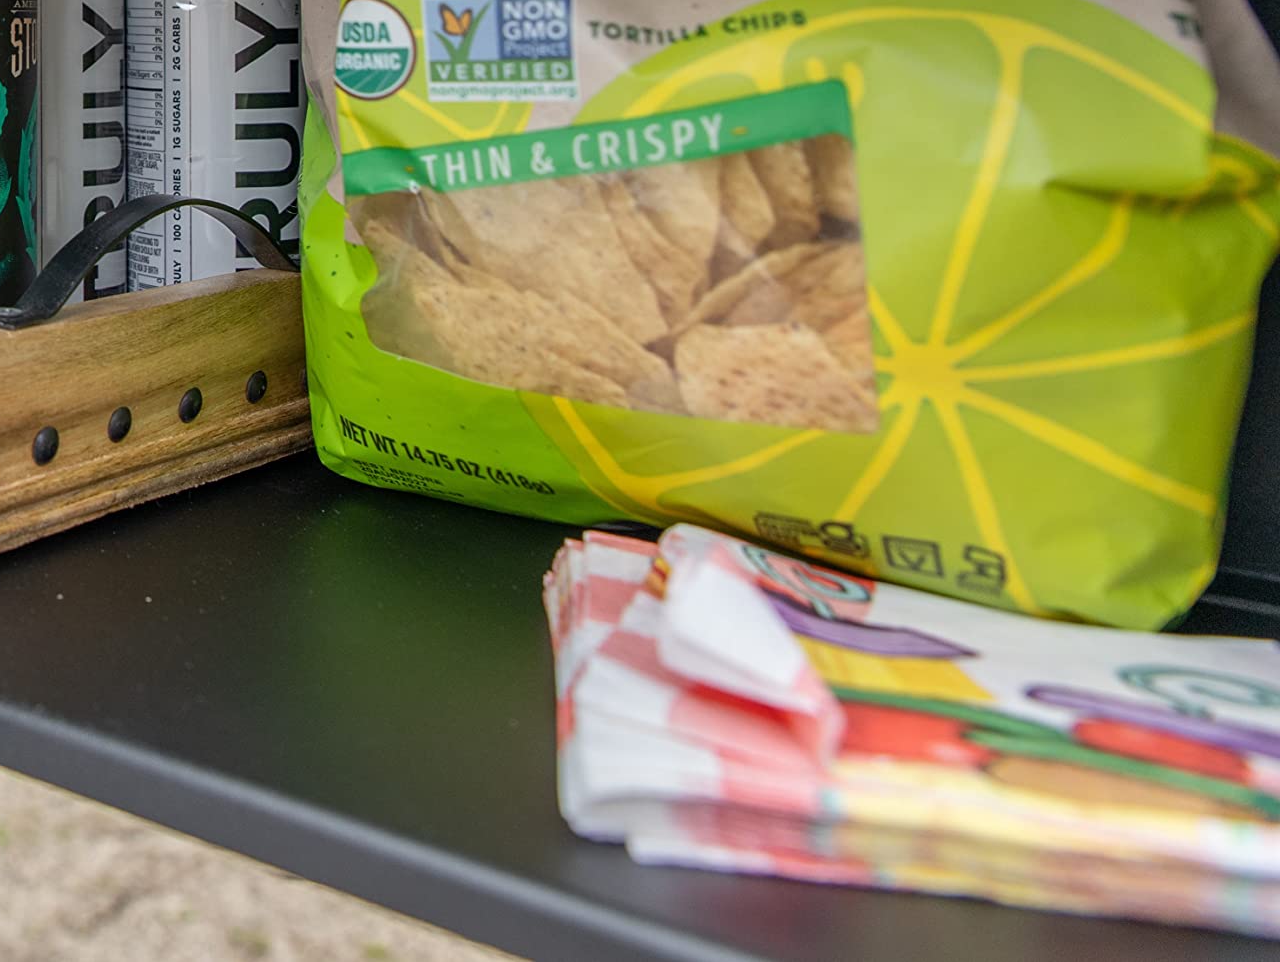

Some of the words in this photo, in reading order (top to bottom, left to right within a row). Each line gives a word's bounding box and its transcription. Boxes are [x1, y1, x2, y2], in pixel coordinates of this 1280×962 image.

[502, 0, 567, 19] NON
[173, 17, 181, 53] CARBS
[342, 21, 391, 43] USDA
[502, 21, 568, 39] GMO
[588, 19, 708, 46] TORTILLA
[722, 9, 808, 35] CHIPS
[336, 52, 401, 70] ORGANIC
[504, 41, 568, 59] Project
[173, 57, 181, 70] 2G
[436, 62, 569, 81] VERIFIED
[173, 90, 181, 133] SUGARS
[173, 137, 181, 149] 1G
[235, 1, 300, 273] RULY
[420, 145, 512, 188] THIN
[529, 141, 556, 176] &
[571, 113, 725, 169] CRISPY
[173, 169, 182, 221] CAORIES
[173, 224, 182, 241] 100
[173, 261, 182, 285] RULY
[339, 413, 368, 449] NET
[370, 430, 399, 458] WT
[401, 441, 455, 472] 14.75
[455, 460, 488, 481] OZ
